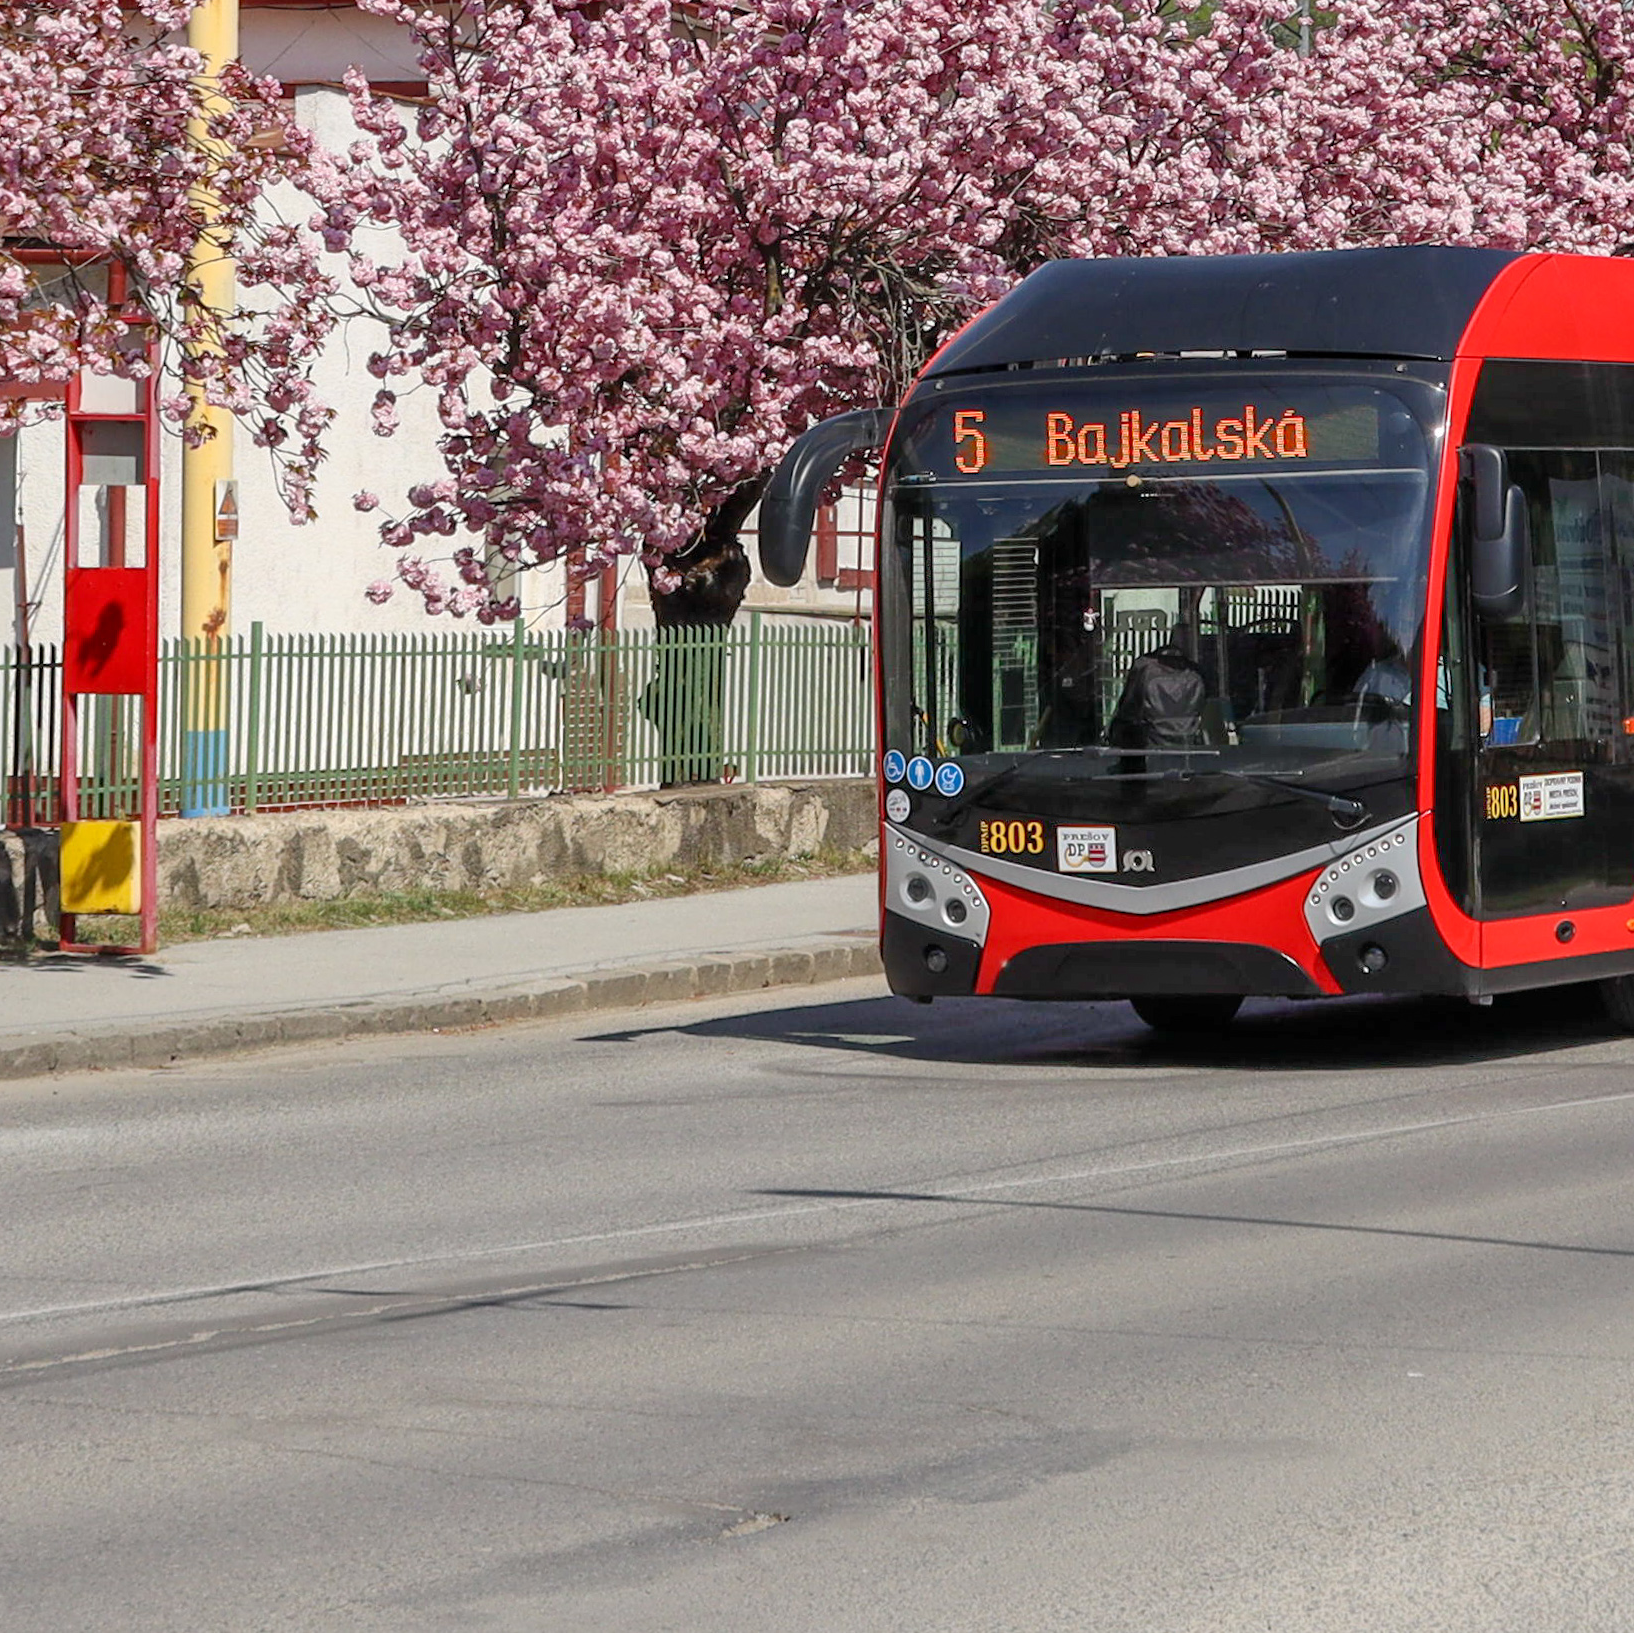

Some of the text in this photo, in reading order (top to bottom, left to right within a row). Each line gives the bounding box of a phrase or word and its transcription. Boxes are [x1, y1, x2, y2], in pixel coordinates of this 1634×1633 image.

[955, 406, 1307, 473] 5 Bajkalská
[1491, 785, 1517, 819] 803
[980, 820, 990, 853] DPMP
[990, 821, 1044, 854] 803
[1062, 831, 1109, 840] PREŠOV
[1067, 843, 1085, 856] DP
